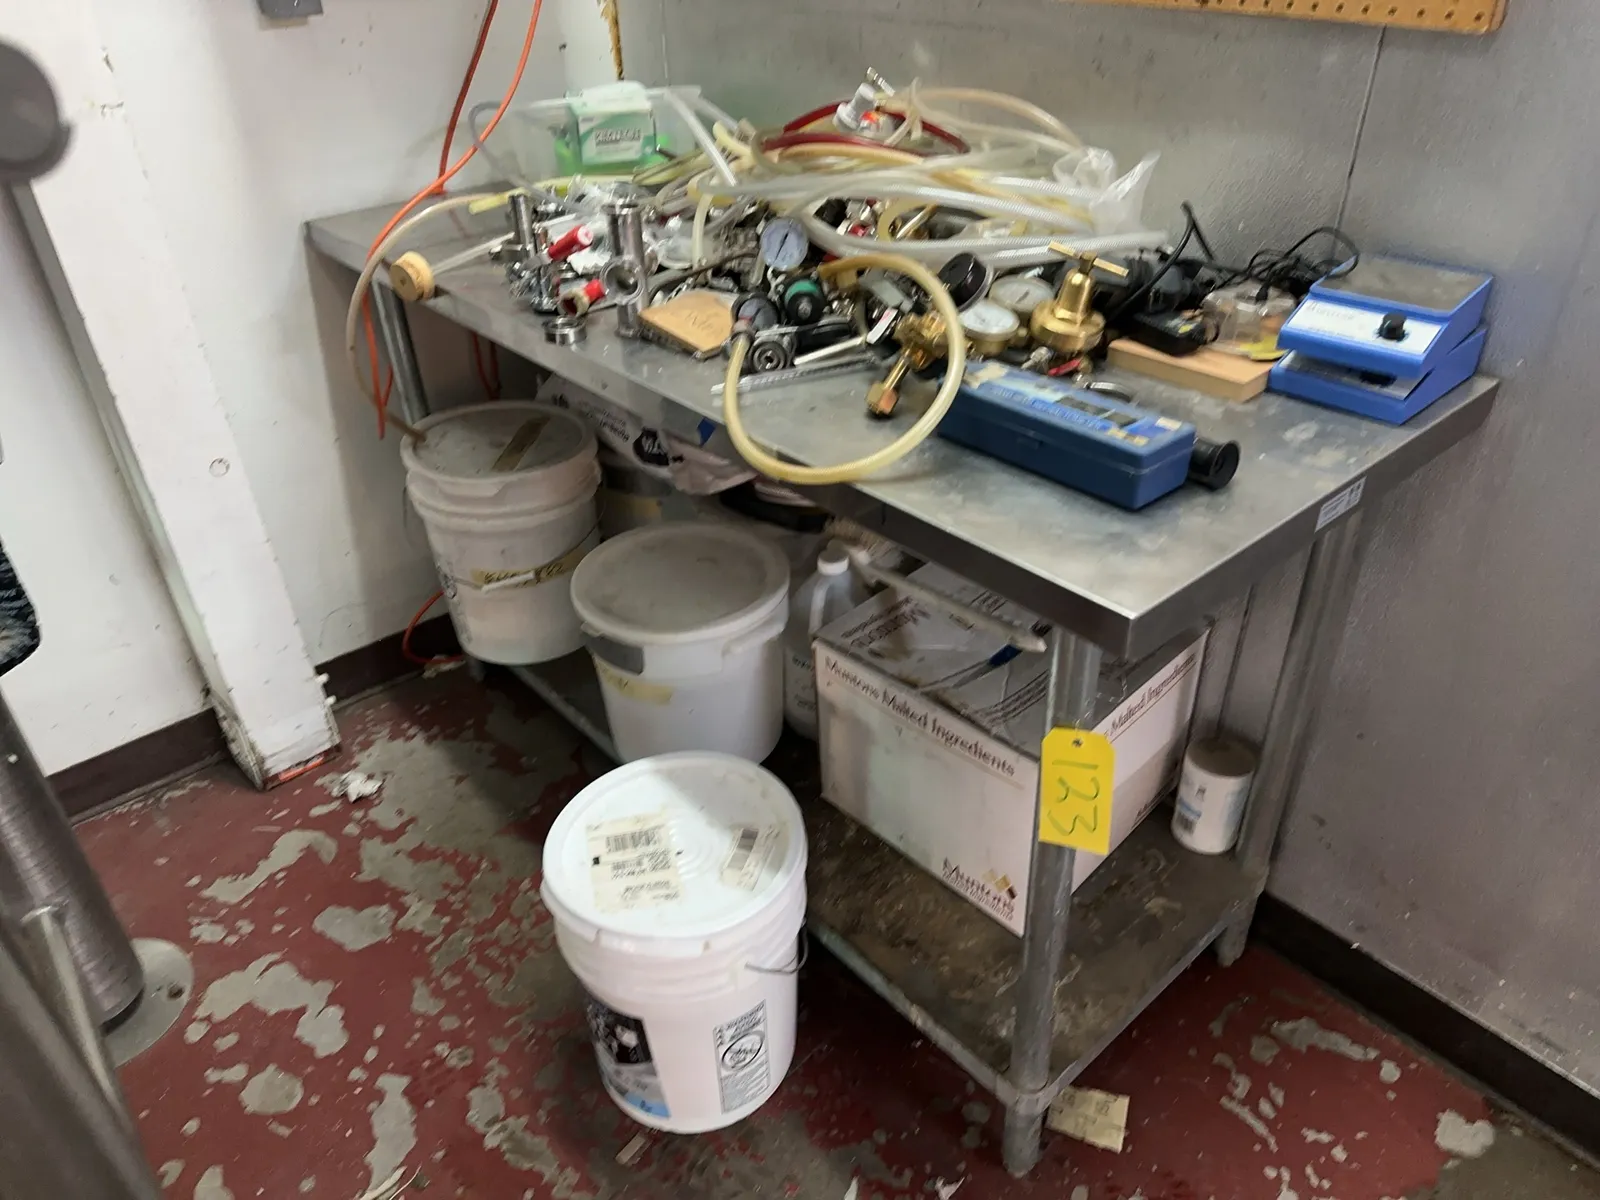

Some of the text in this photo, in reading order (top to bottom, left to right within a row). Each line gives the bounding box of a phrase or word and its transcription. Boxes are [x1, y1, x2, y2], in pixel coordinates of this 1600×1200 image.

[882, 687, 928, 730] Malted
[931, 718, 1015, 777] Ingredients
[1047, 759, 1100, 836] 123
